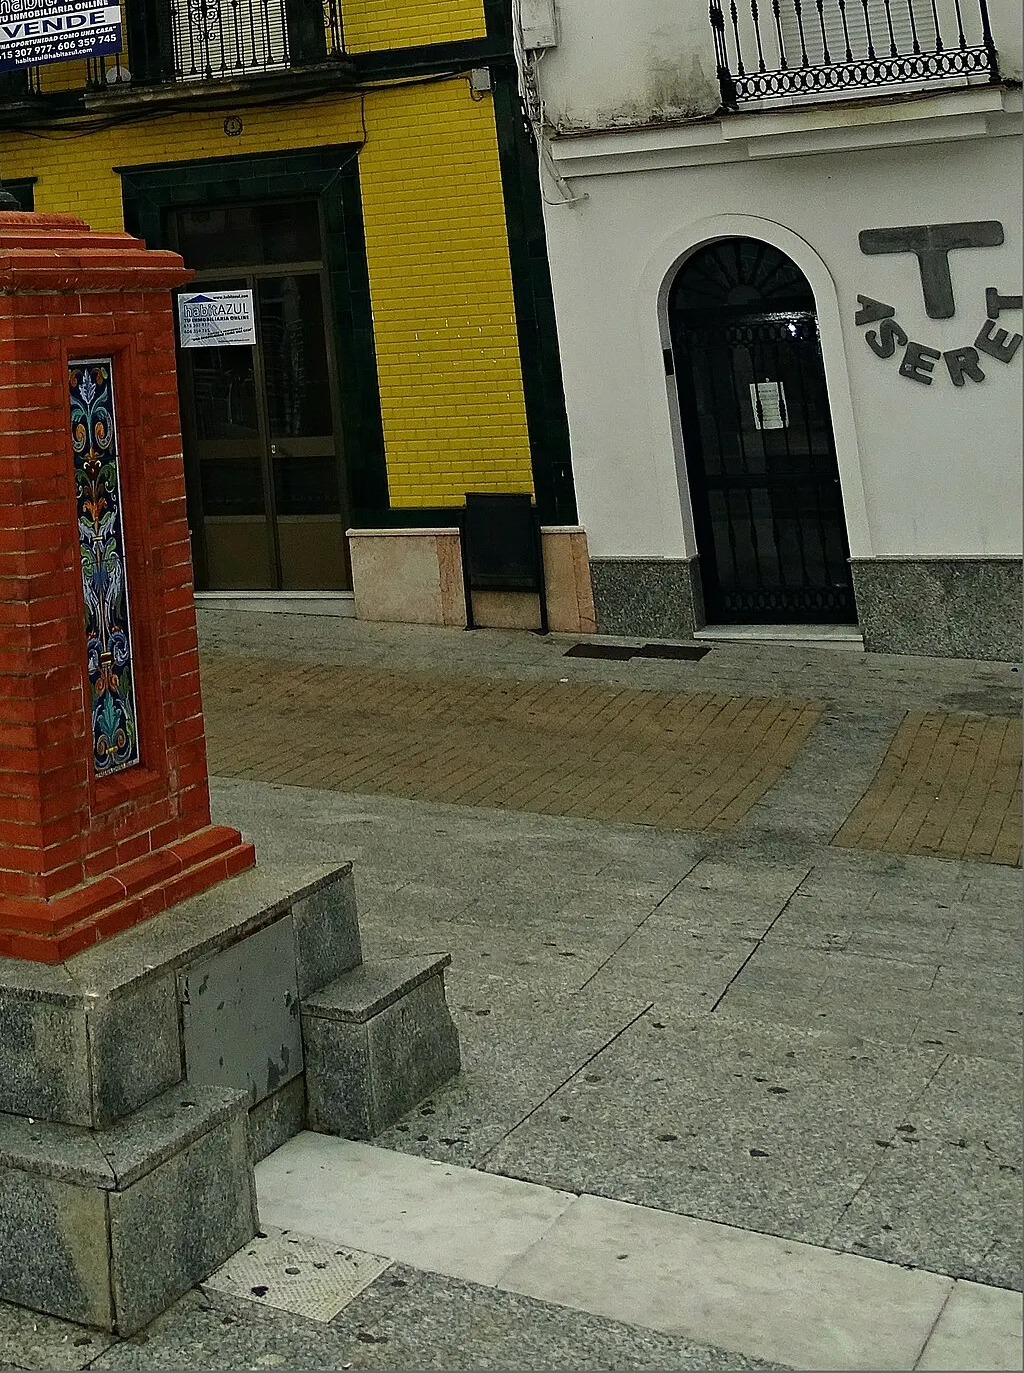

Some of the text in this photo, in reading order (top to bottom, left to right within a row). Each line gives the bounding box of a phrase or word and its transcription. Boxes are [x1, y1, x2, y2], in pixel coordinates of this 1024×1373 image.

[10, 5, 73, 21] INMOBILIARIA
[75, 0, 108, 10] ONLINE
[1, 10, 105, 38] VENDE
[11, 35, 58, 48] OPORTUNIDAD
[59, 32, 79, 40] COMO
[81, 29, 94, 37] UNA
[15, 48, 32, 58] 307
[58, 41, 75, 50] 606
[78, 38, 96, 47] 359
[98, 34, 116, 43] 745
[15, 48, 93, 64] habitazul@habitazul.com
[858, 220, 1004, 319] T
[184, 303, 249, 317] habitAZUL
